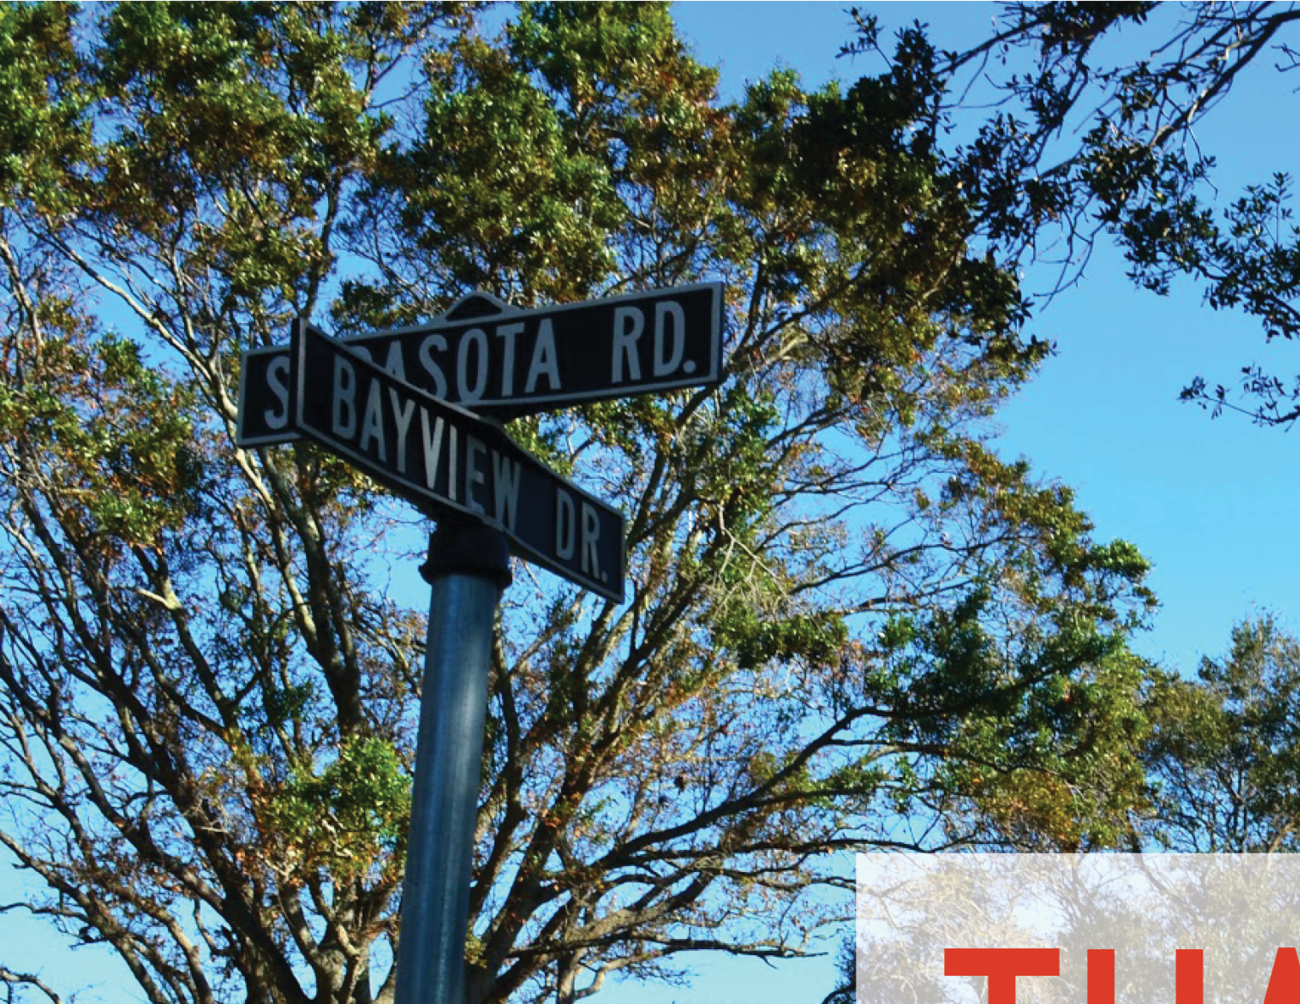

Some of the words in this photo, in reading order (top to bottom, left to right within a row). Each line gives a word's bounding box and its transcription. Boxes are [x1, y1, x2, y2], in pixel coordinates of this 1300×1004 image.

[264, 318, 562, 430] SASOTA
[612, 301, 696, 383] RD.
[332, 353, 521, 531] BAYVIEW
